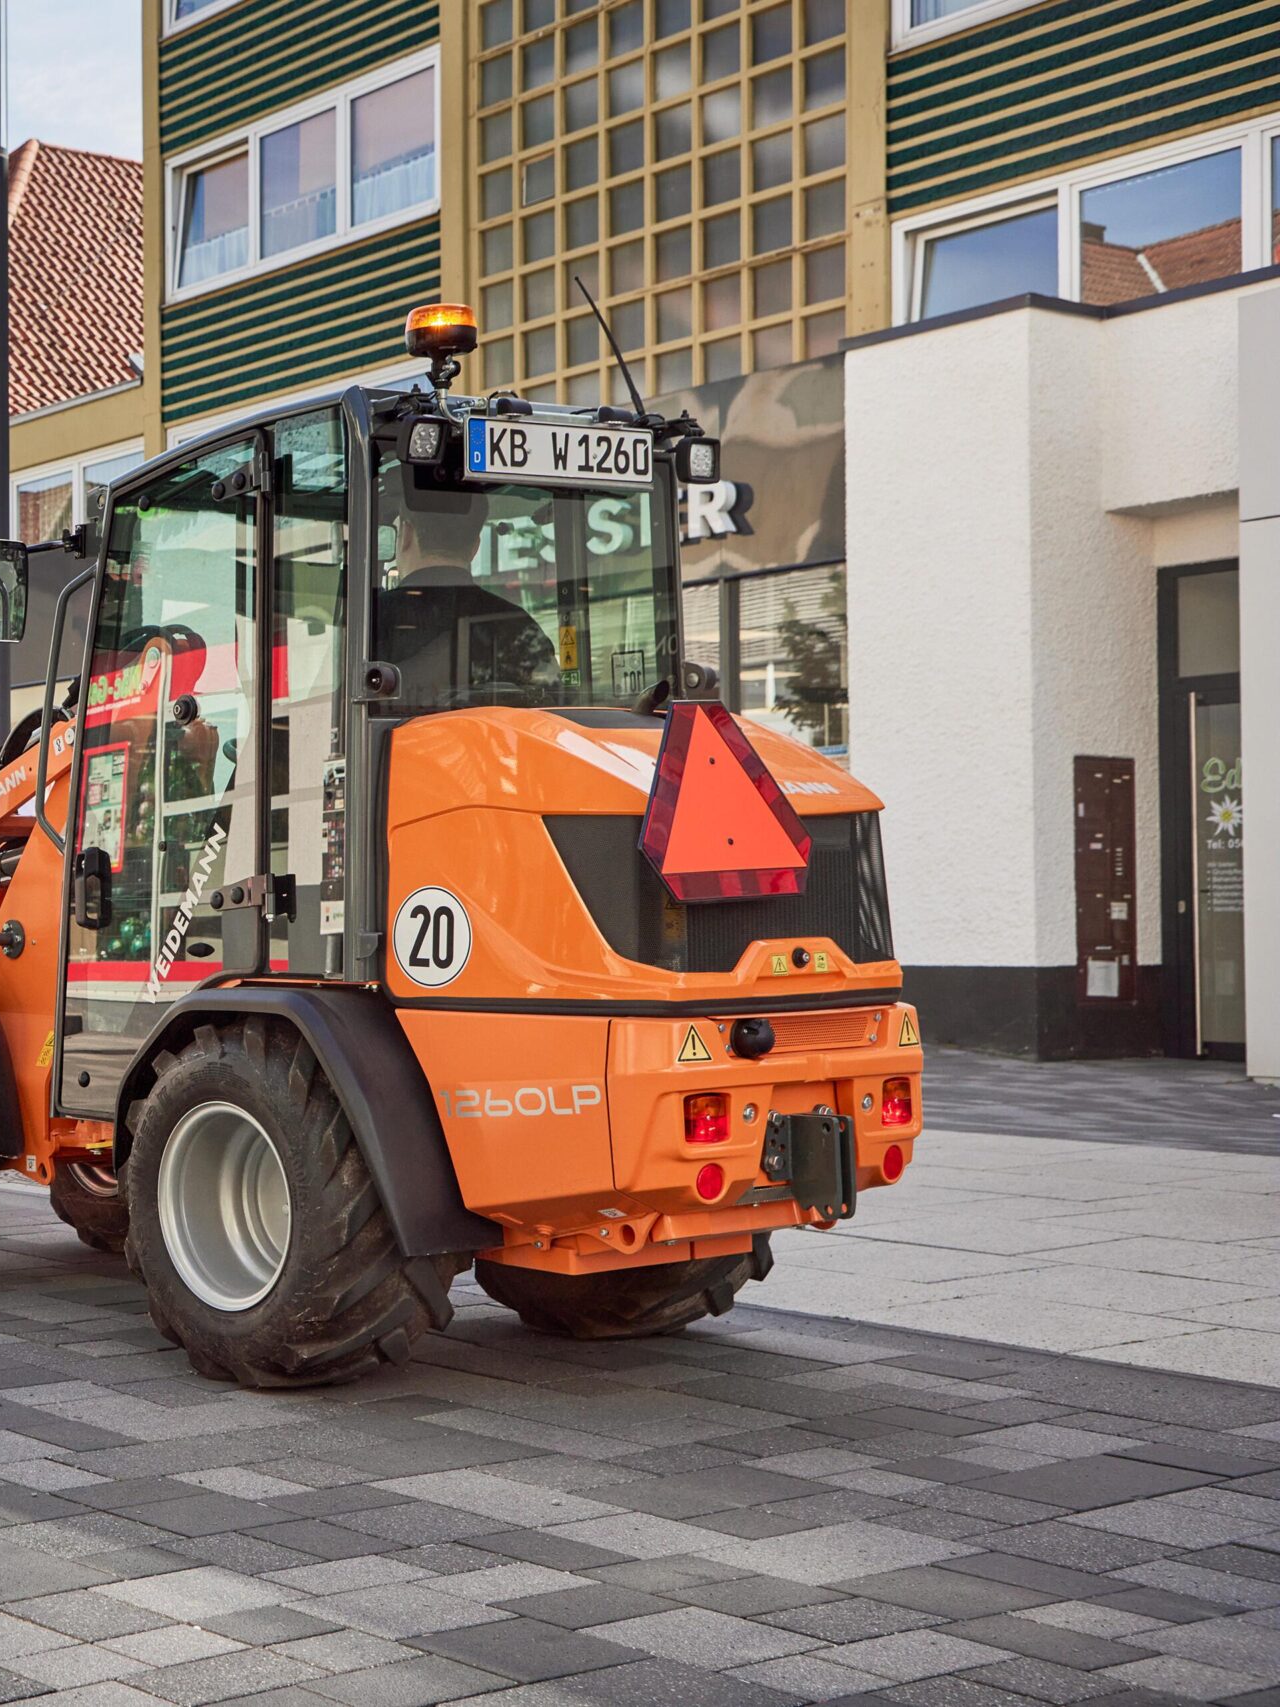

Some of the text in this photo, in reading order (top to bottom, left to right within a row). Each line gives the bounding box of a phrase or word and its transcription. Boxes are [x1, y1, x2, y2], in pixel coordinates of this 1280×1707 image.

[473, 451, 481, 463] D
[489, 427, 528, 467] KB
[142, 822, 227, 1004] WEIDEMANN
[409, 904, 455, 970] 20
[440, 1084, 602, 1118] 1260LP
